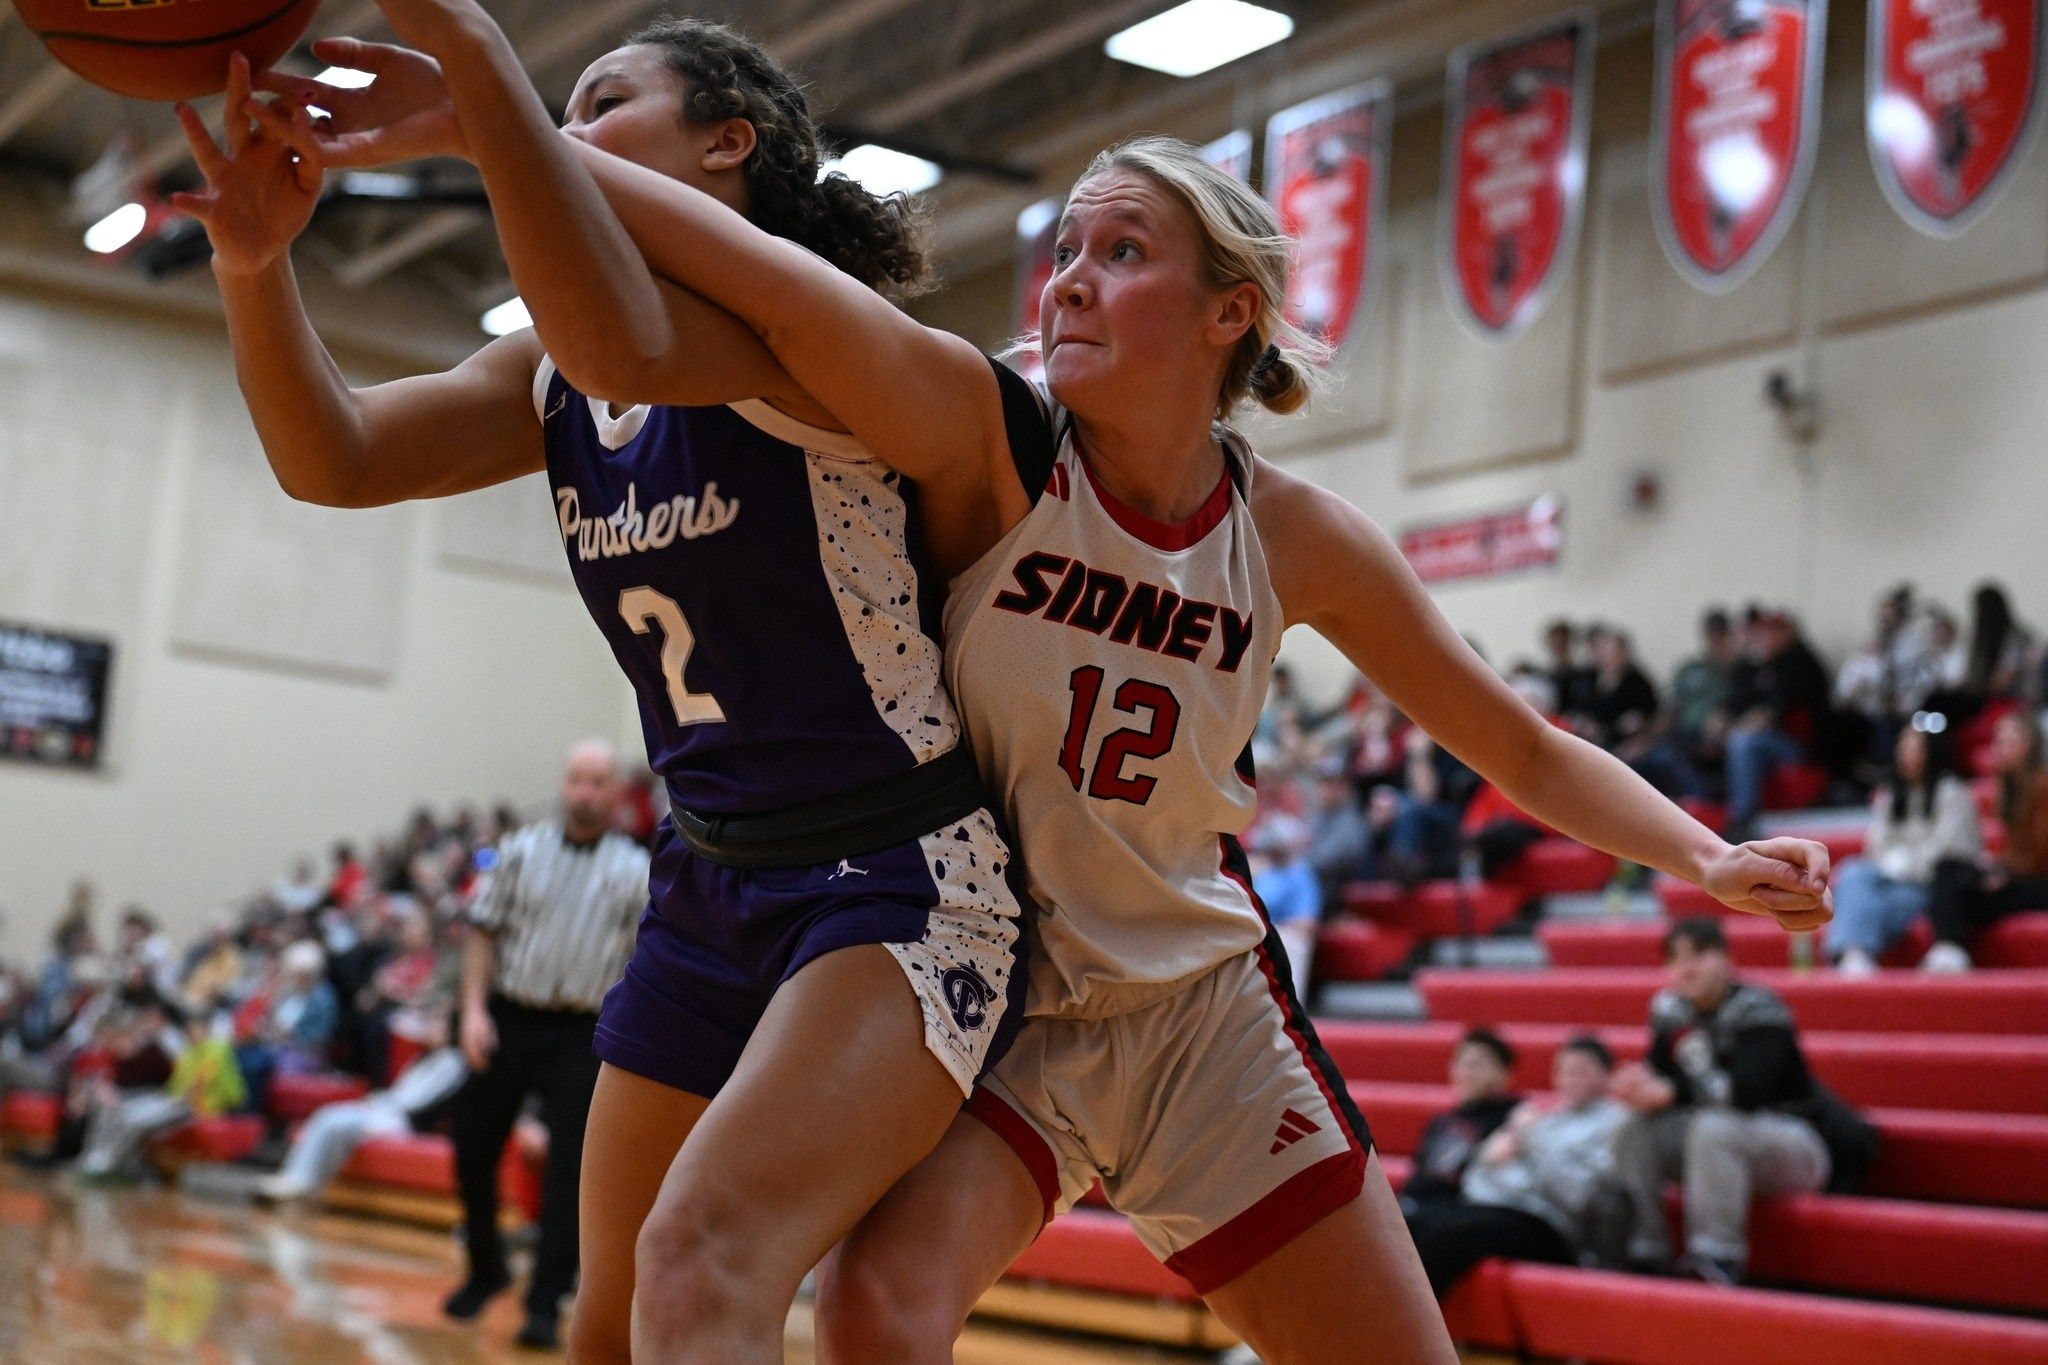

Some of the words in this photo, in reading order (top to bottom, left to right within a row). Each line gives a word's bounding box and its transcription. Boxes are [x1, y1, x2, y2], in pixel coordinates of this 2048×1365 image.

[556, 480, 741, 562] Panthers
[617, 584, 727, 728] 2
[991, 550, 1253, 673] SIDNEY
[1057, 664, 1181, 806] 12
